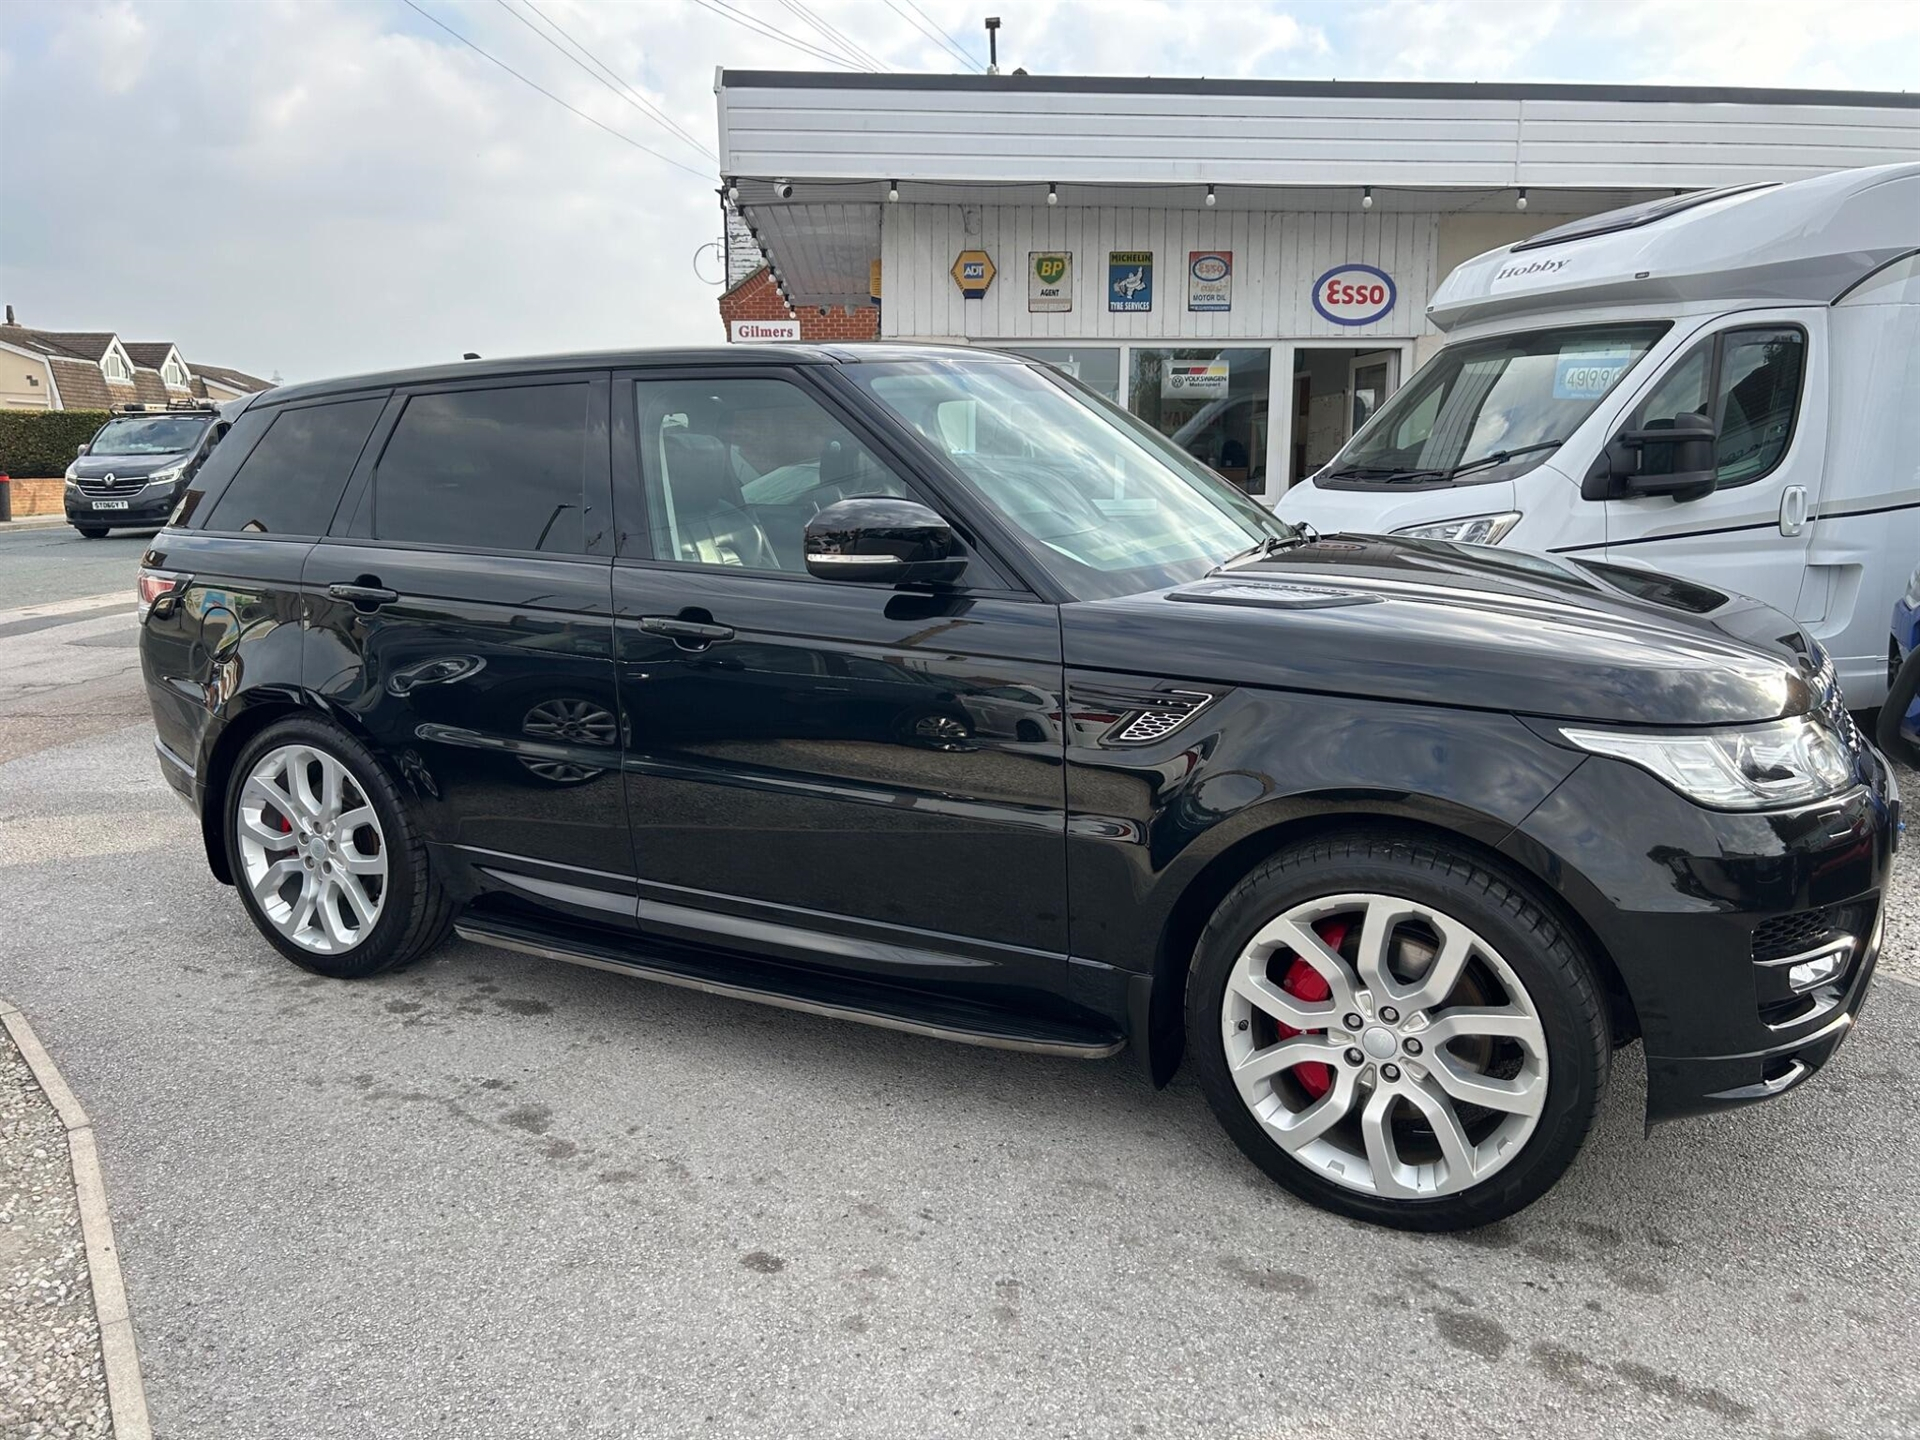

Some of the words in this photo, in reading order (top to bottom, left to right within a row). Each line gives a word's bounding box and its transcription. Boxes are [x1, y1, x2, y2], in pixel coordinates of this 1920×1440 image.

[1111, 254, 1151, 262] MICHELIN
[964, 265, 984, 276] ADT
[1040, 261, 1063, 276] BP
[1496, 259, 1572, 280] Hobby
[1040, 289, 1060, 297] AGENT
[1110, 301, 1124, 310] TYRE
[1125, 301, 1150, 310] SERVICES
[738, 325, 794, 338] Gilmers
